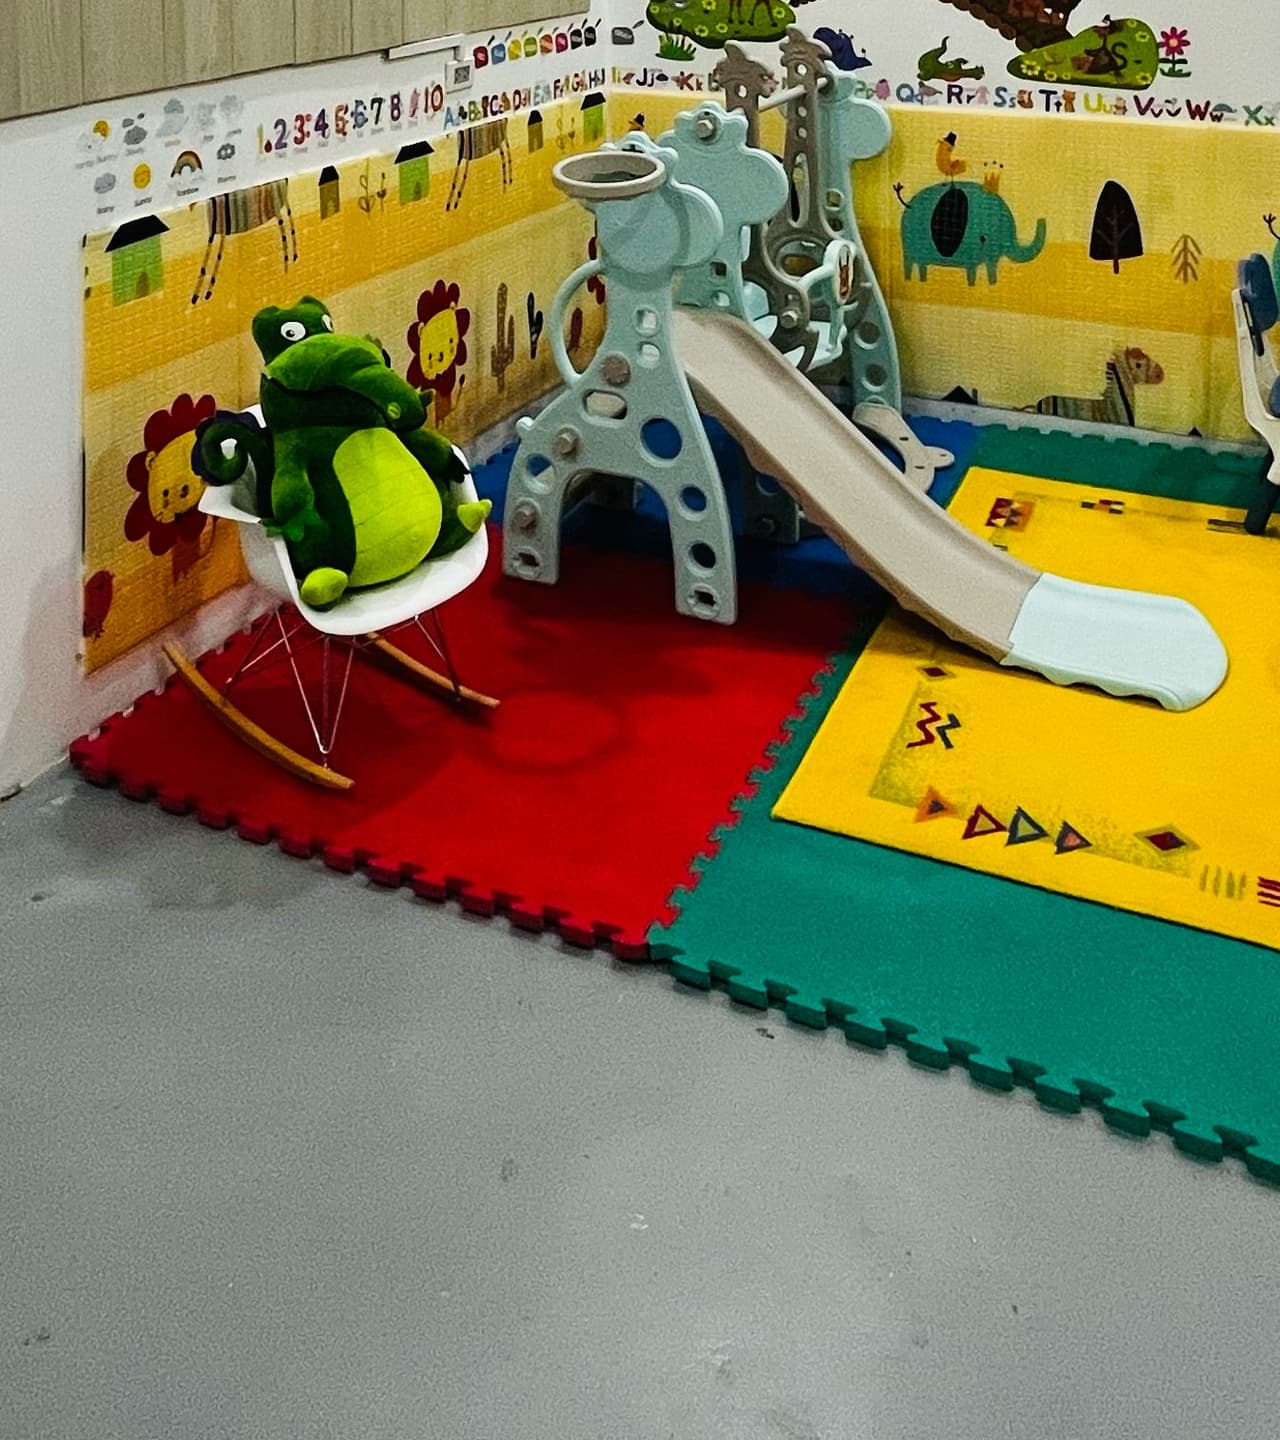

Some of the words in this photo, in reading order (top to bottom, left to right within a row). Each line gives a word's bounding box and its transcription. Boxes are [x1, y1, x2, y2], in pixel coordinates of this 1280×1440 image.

[274, 118, 288, 150] 2
[293, 114, 307, 145] 3
[314, 108, 329, 138] 4
[370, 97, 384, 126] 7
[390, 91, 401, 122] 8
[424, 83, 444, 113] 10
[947, 84, 976, 104] Rr
[993, 86, 1017, 108] Ss
[1039, 89, 1062, 112] Tt
[1083, 92, 1114, 113] Uu
[1133, 95, 1163, 118] Vv
[1186, 99, 1224, 123] Ww
[1242, 104, 1275, 126] Xx
